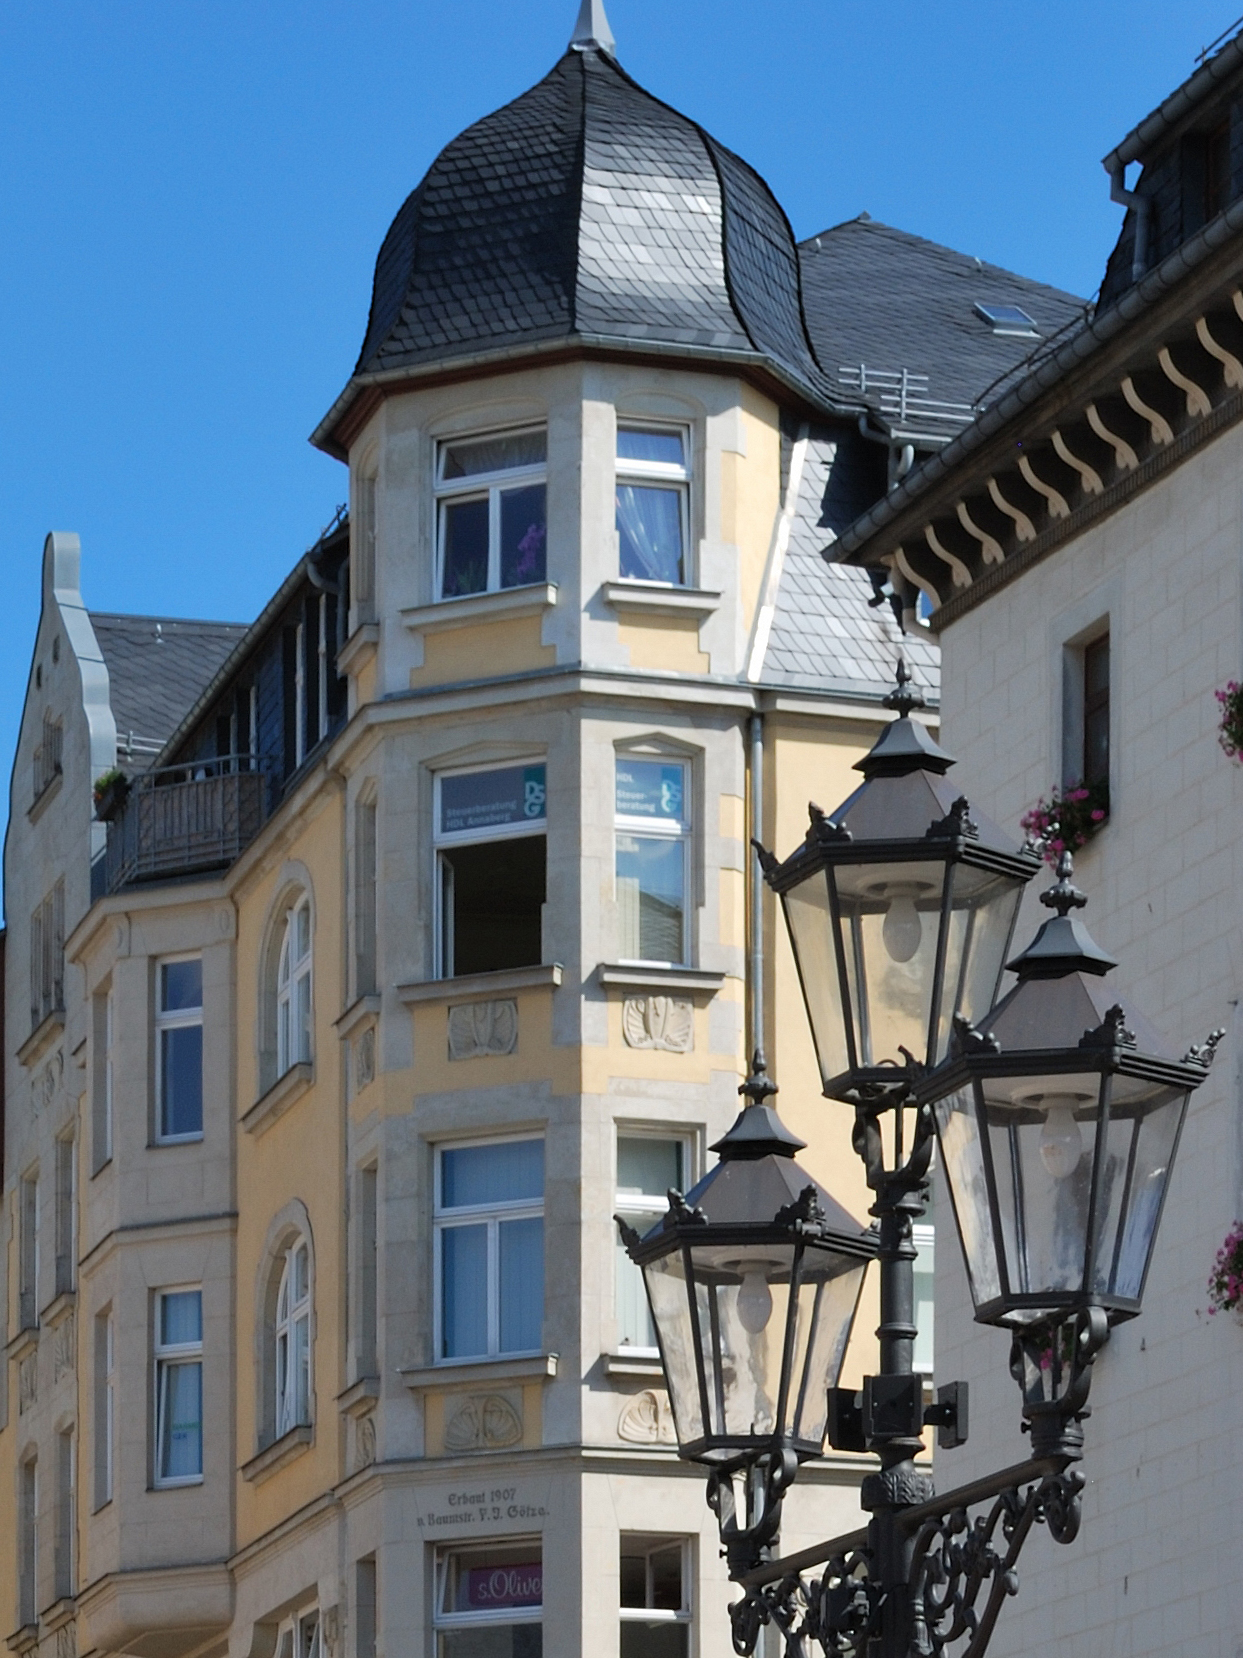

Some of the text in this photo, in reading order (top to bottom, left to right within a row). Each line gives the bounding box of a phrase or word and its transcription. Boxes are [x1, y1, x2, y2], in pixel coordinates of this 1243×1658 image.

[447, 800, 517, 817] Steuerberatung
[617, 800, 655, 812] beratung
[467, 812, 511, 826] Annaberg
[448, 1488, 516, 1506] Erbaut 1907
[478, 1570, 542, 1600] s.Olive
